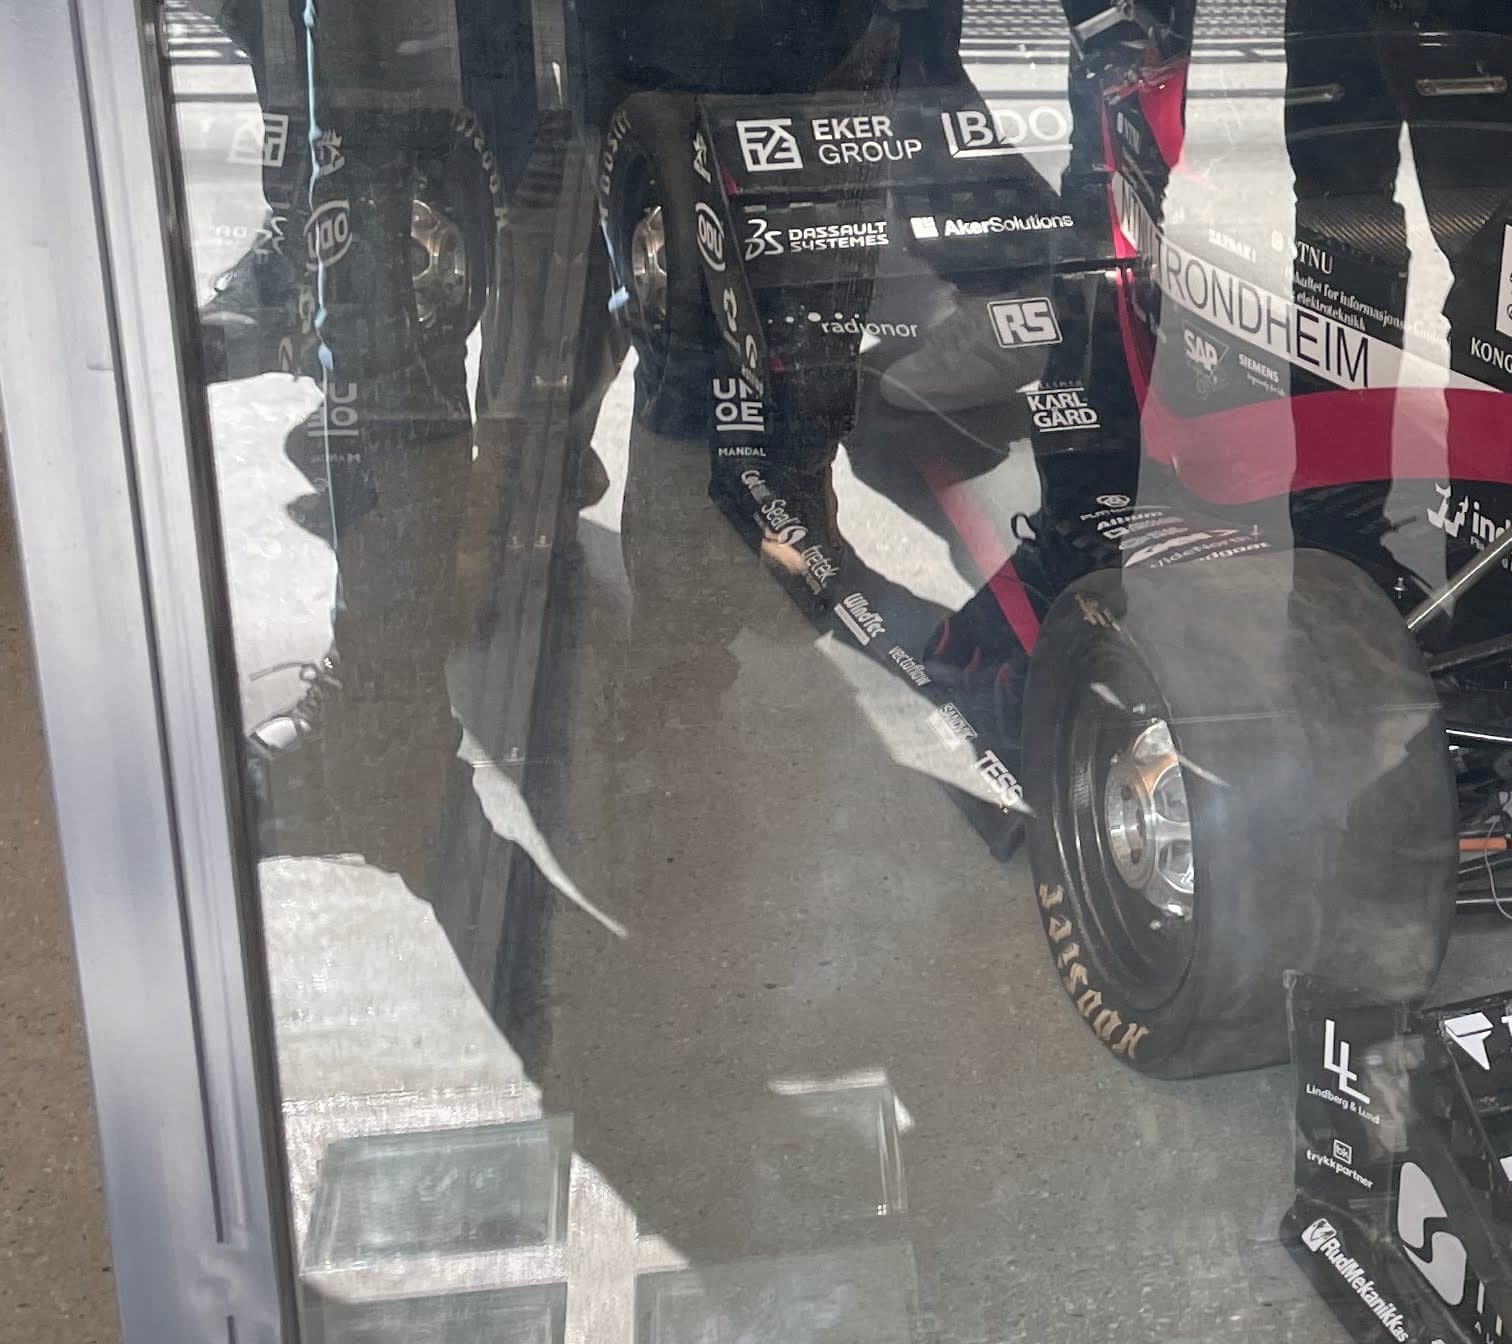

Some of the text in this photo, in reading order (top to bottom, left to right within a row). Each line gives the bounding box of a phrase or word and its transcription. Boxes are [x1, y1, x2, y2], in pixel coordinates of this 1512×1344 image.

[812, 116, 893, 141] EKER
[958, 108, 1067, 147] BDO
[818, 138, 923, 166] GROUP
[789, 221, 888, 240] DASSAULT
[1290, 240, 1334, 275] TNU
[820, 318, 919, 338] radionor
[993, 303, 1057, 345] RS
[1184, 329, 1218, 371] SAP
[1238, 354, 1280, 383] SIEMENS
[718, 446, 767, 458] MANDAL
[973, 750, 1025, 809] TESS
[1306, 1083, 1349, 1113] Lindberg
[1358, 1105, 1381, 1125] Lund
[1306, 1148, 1374, 1191] trykkpartner
